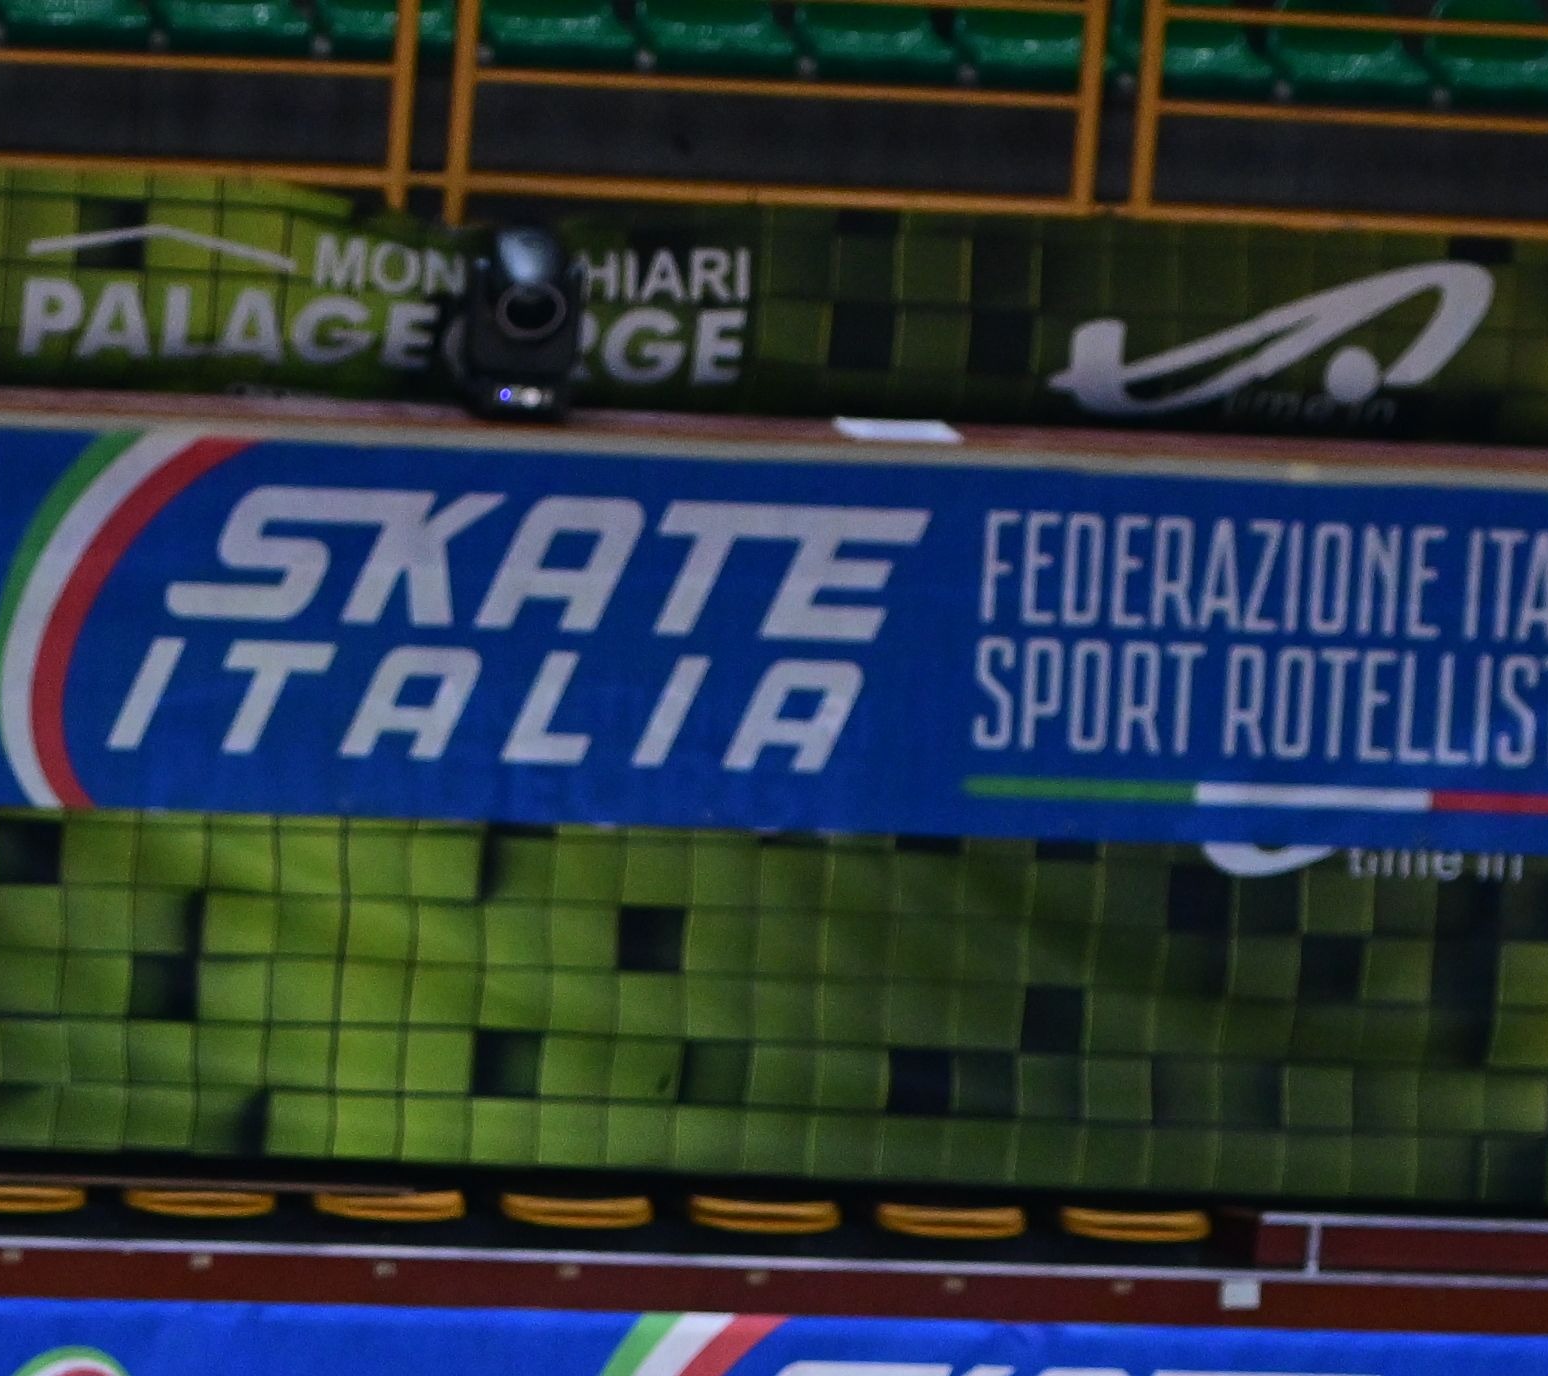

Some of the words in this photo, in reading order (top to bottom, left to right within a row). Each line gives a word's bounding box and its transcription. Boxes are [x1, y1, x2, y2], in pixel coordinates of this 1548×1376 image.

[314, 234, 750, 301] MONHIARI
[19, 278, 745, 383] PALAGEGE
[165, 486, 931, 642] SKATE
[980, 509, 1445, 640] FEDERAZIONE
[106, 637, 864, 772] ITALIA
[972, 637, 1205, 755] SPORT
